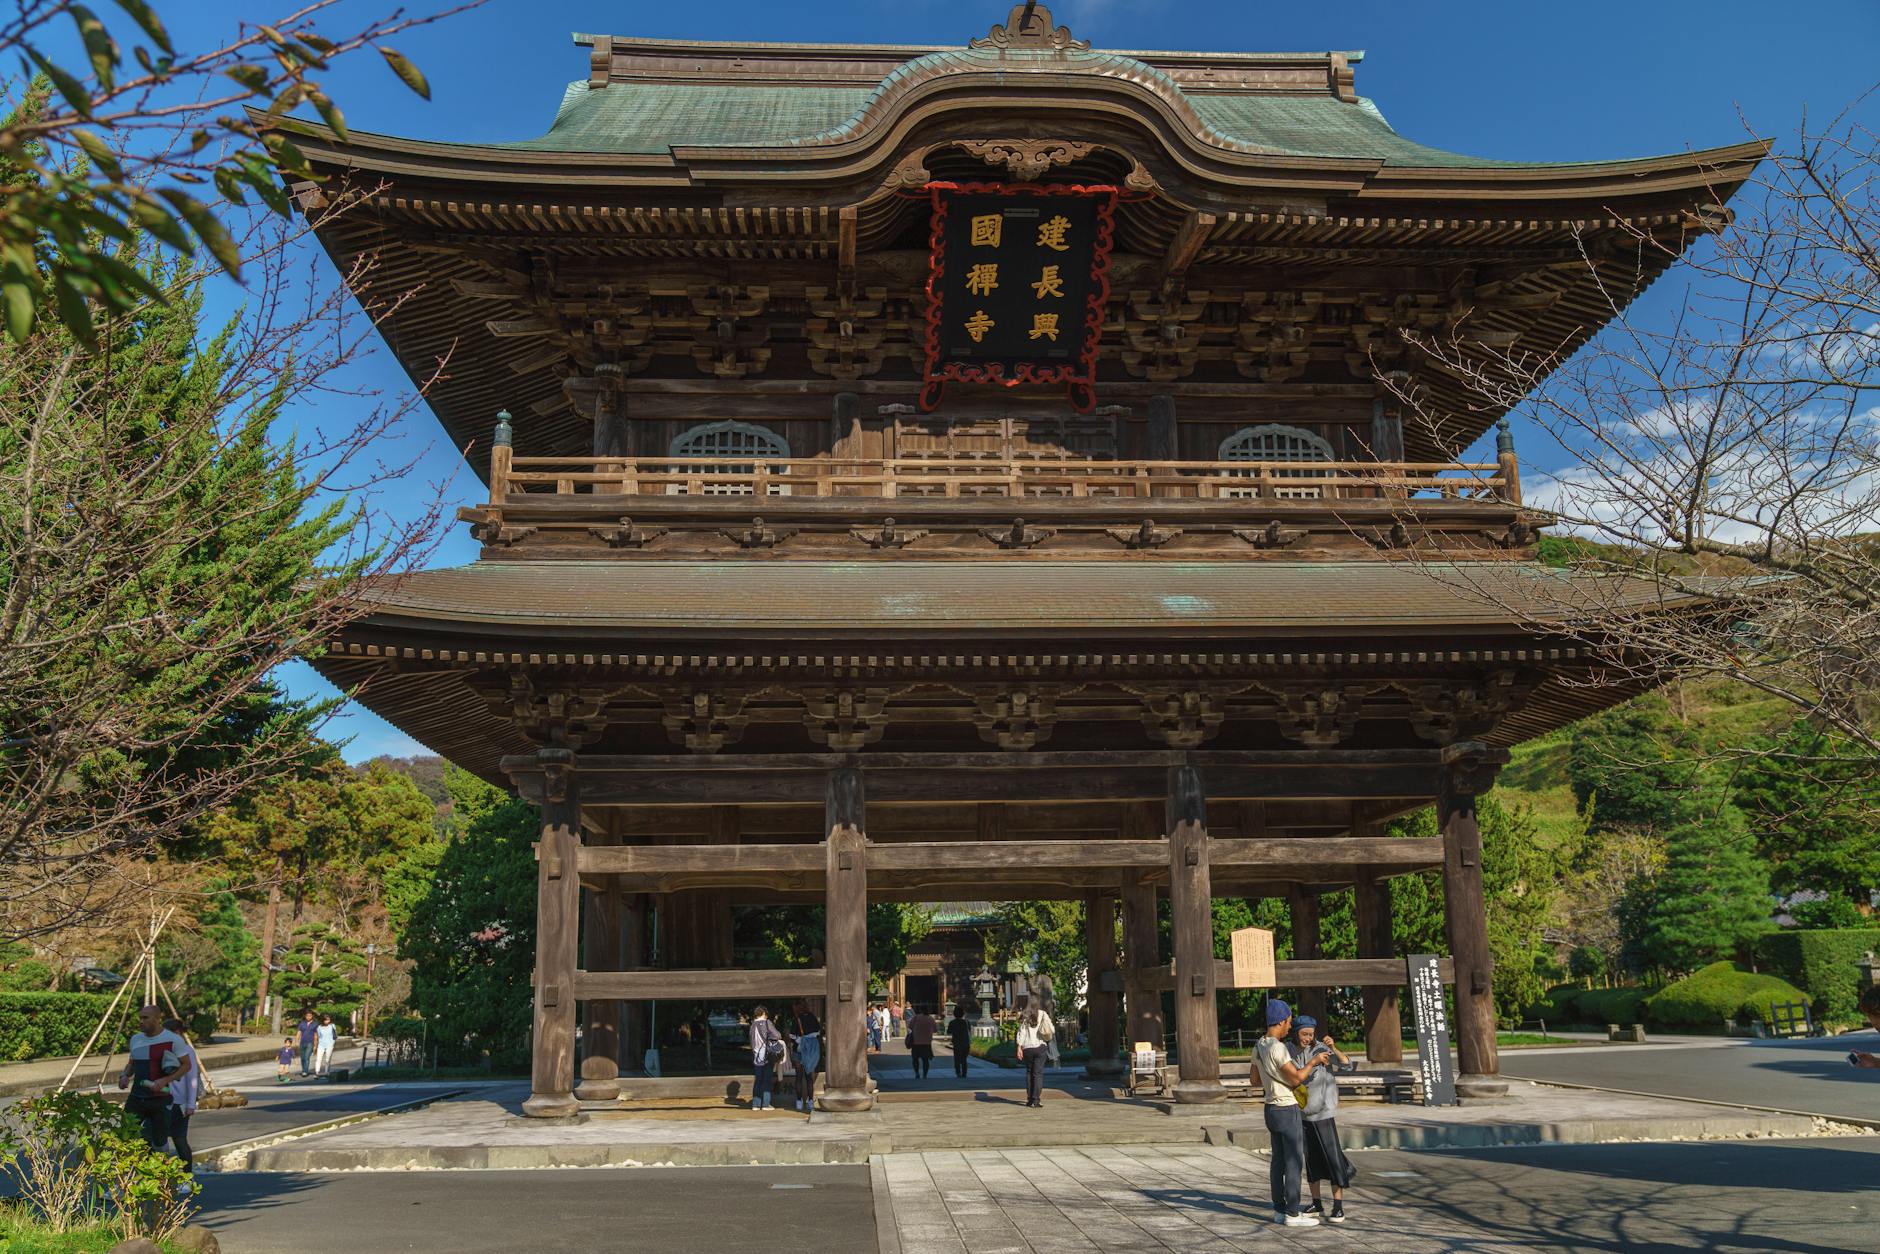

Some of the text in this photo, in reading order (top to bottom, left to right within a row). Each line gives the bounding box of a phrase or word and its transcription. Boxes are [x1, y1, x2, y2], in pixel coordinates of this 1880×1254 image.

[964, 213, 1003, 343] 國禪寺
[1028, 214, 1072, 342] 建長興
